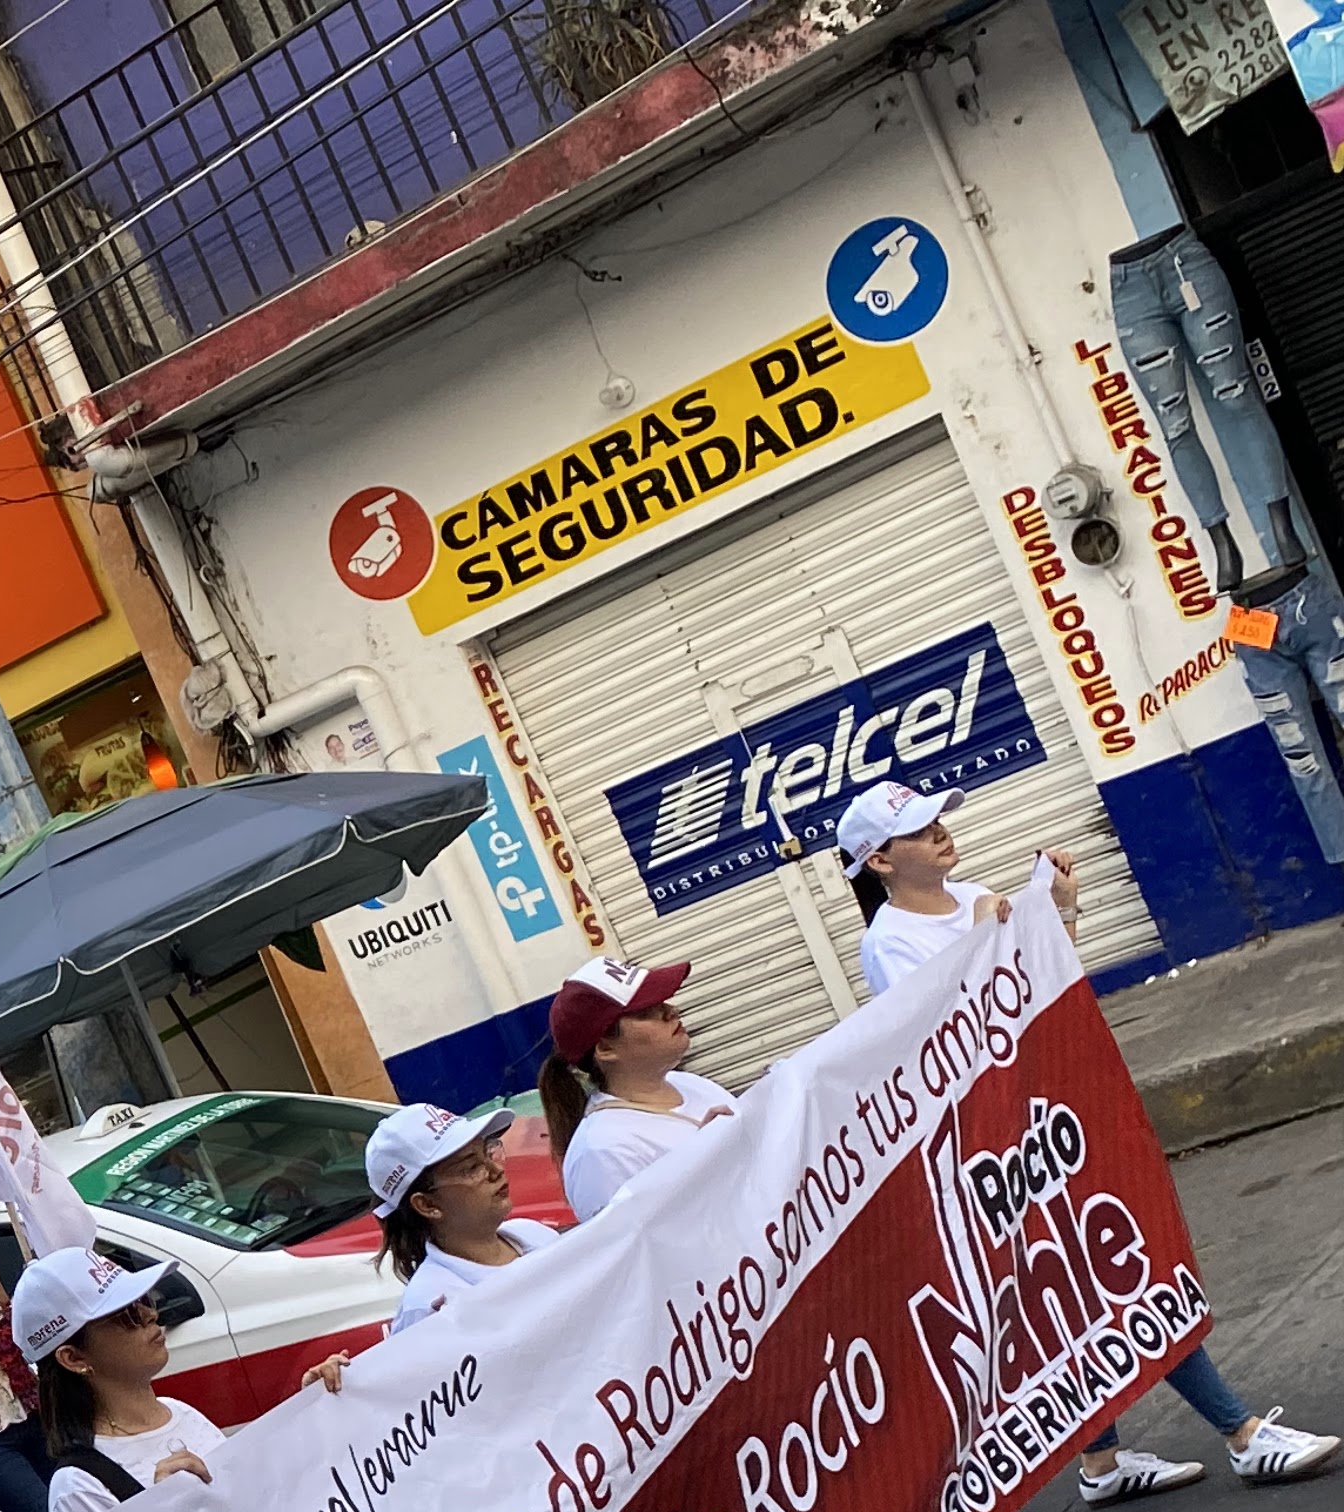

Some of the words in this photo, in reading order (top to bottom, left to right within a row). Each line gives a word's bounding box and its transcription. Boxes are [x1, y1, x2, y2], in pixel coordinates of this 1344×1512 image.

[1160, 23, 1210, 73] EN
[440, 388, 718, 552] CÁMARAS
[749, 322, 847, 399] DE
[1247, 341, 1282, 398] 502
[455, 386, 856, 604] SEGURIDAD.
[1073, 339, 1217, 619] LIBERACIONES
[1000, 486, 1136, 756] DESBLOQUEOS
[94, 736, 127, 759] FRUTAS
[471, 661, 605, 948] RECARGAS
[740, 650, 986, 830] telcel
[347, 900, 452, 960] UBIQUITI
[367, 933, 443, 970] NETWORKS
[107, 1106, 135, 1128] TAXI
[966, 1101, 1083, 1241] Rocío
[596, 1256, 767, 1474] Rodrigo
[766, 1125, 867, 1290] somos
[857, 1066, 918, 1158] tus
[920, 947, 1033, 1098] amigos
[909, 1104, 1150, 1462] Nahle
[26, 1314, 68, 1347] morena
